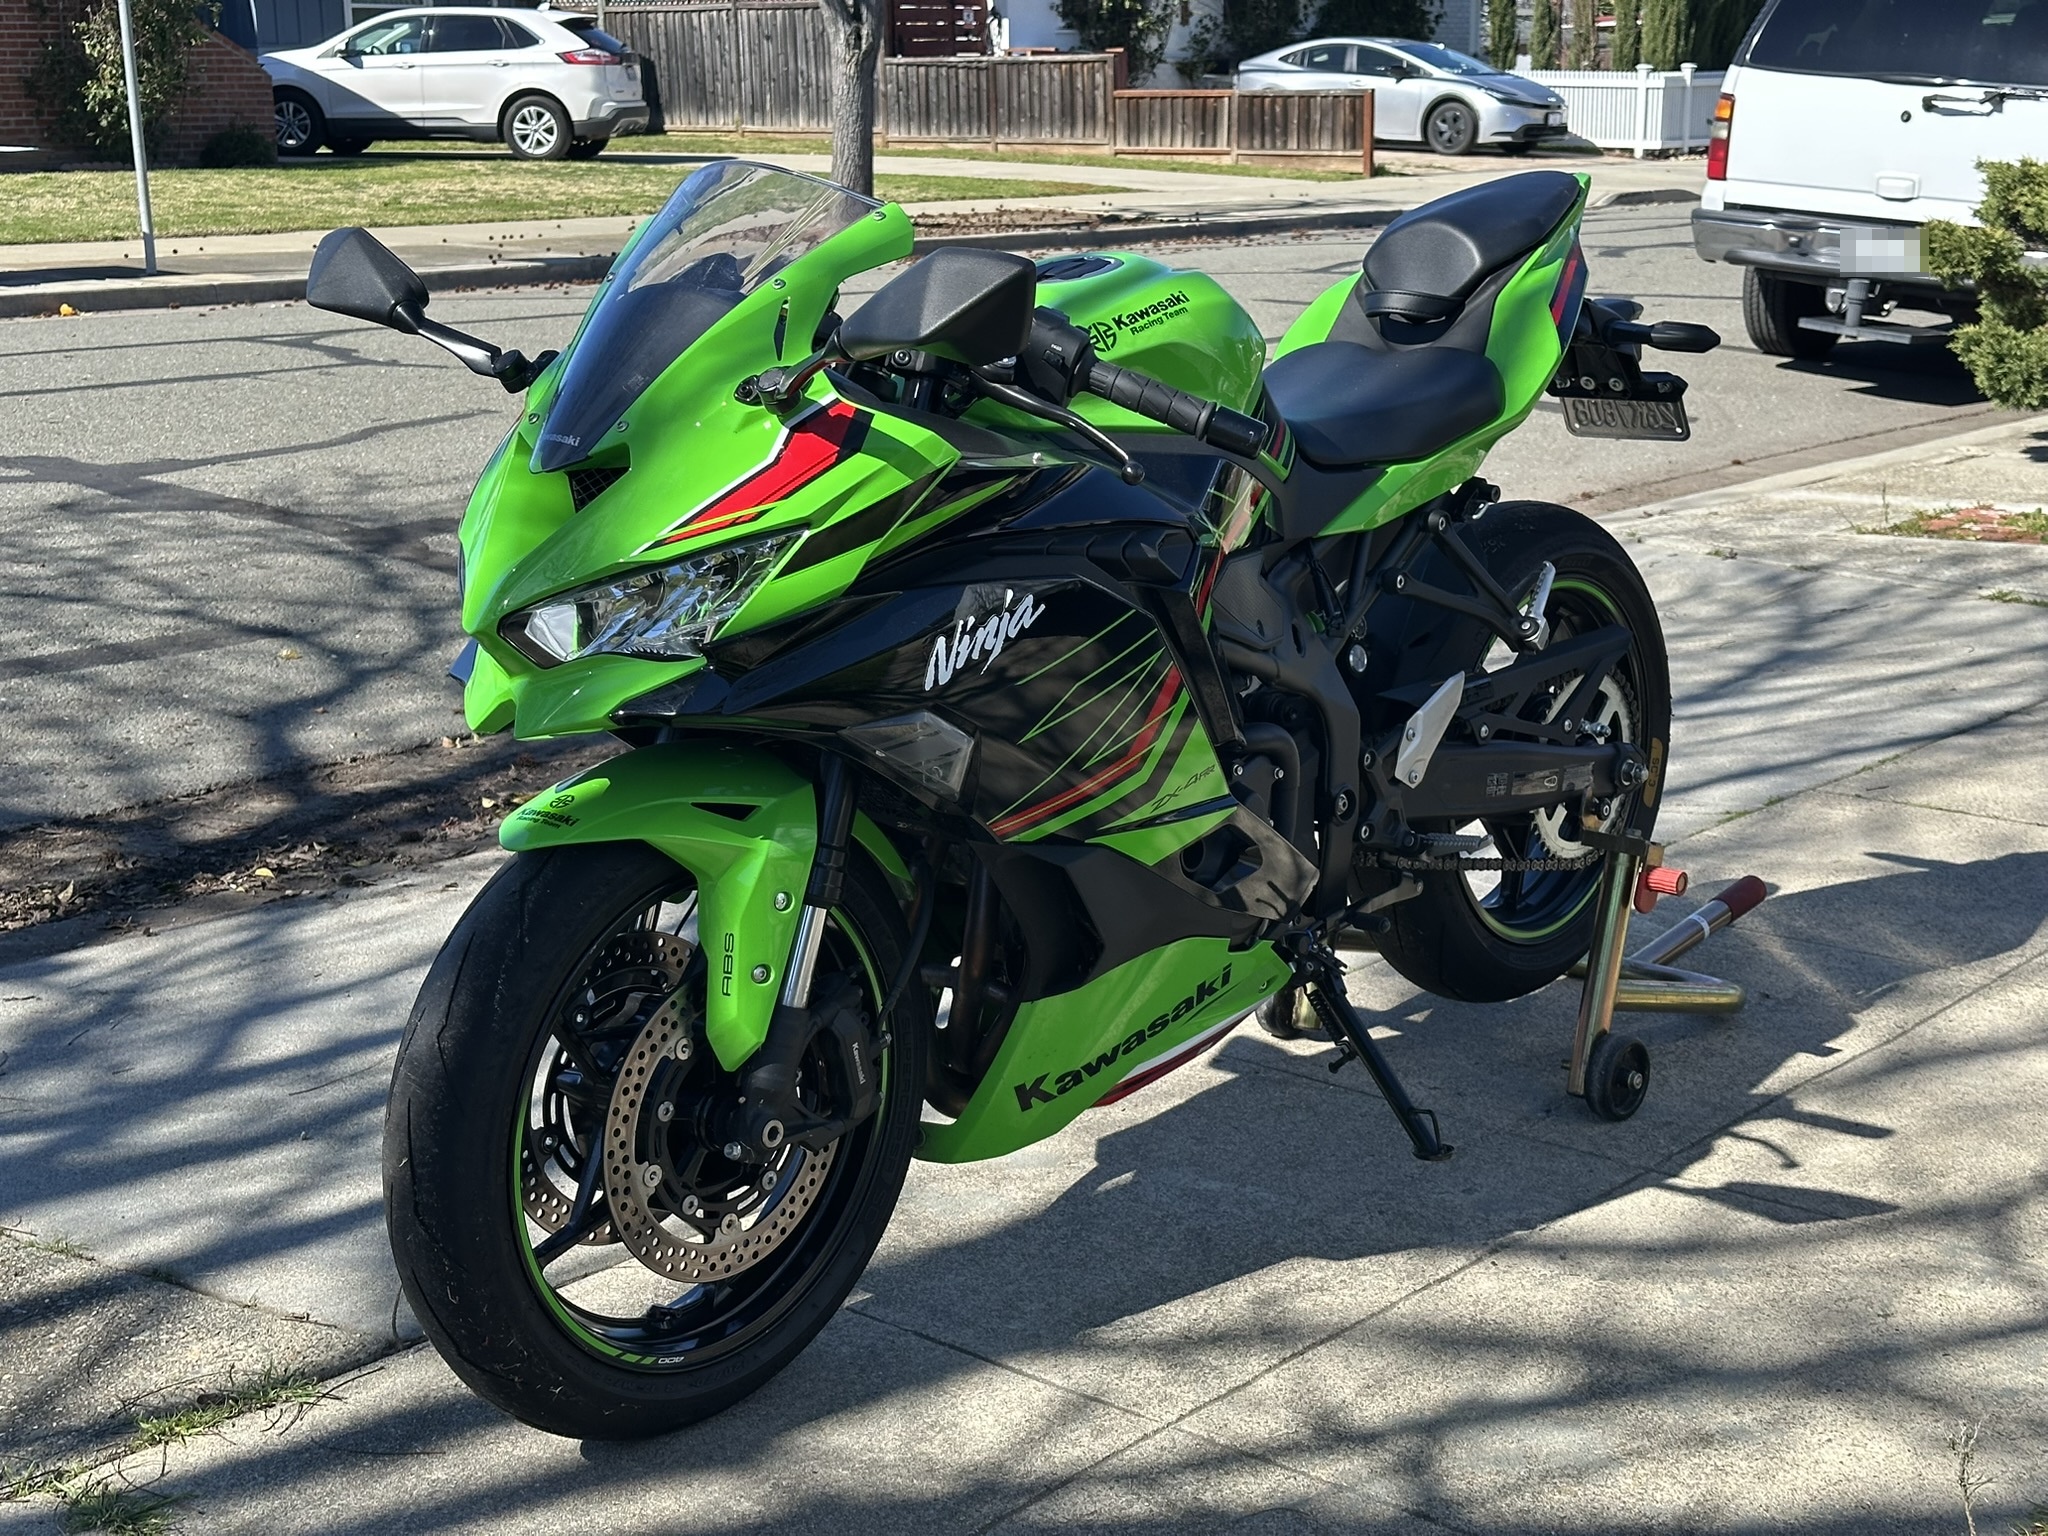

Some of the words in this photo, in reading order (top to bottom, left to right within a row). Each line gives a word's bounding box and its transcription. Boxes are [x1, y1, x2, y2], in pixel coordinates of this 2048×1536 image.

[1111, 290, 1190, 331] Kawasaki
[1129, 317, 1164, 336] Racing
[1162, 305, 1189, 320] Team
[924, 588, 1046, 691] Ninja
[517, 807, 581, 827] Kawasaki
[540, 818, 562, 829] Team
[721, 932, 735, 997] ABS
[1013, 962, 1233, 1113] Kawasaki
[852, 1041, 866, 1085] Kawasaki
[658, 1356, 685, 1364] 400
